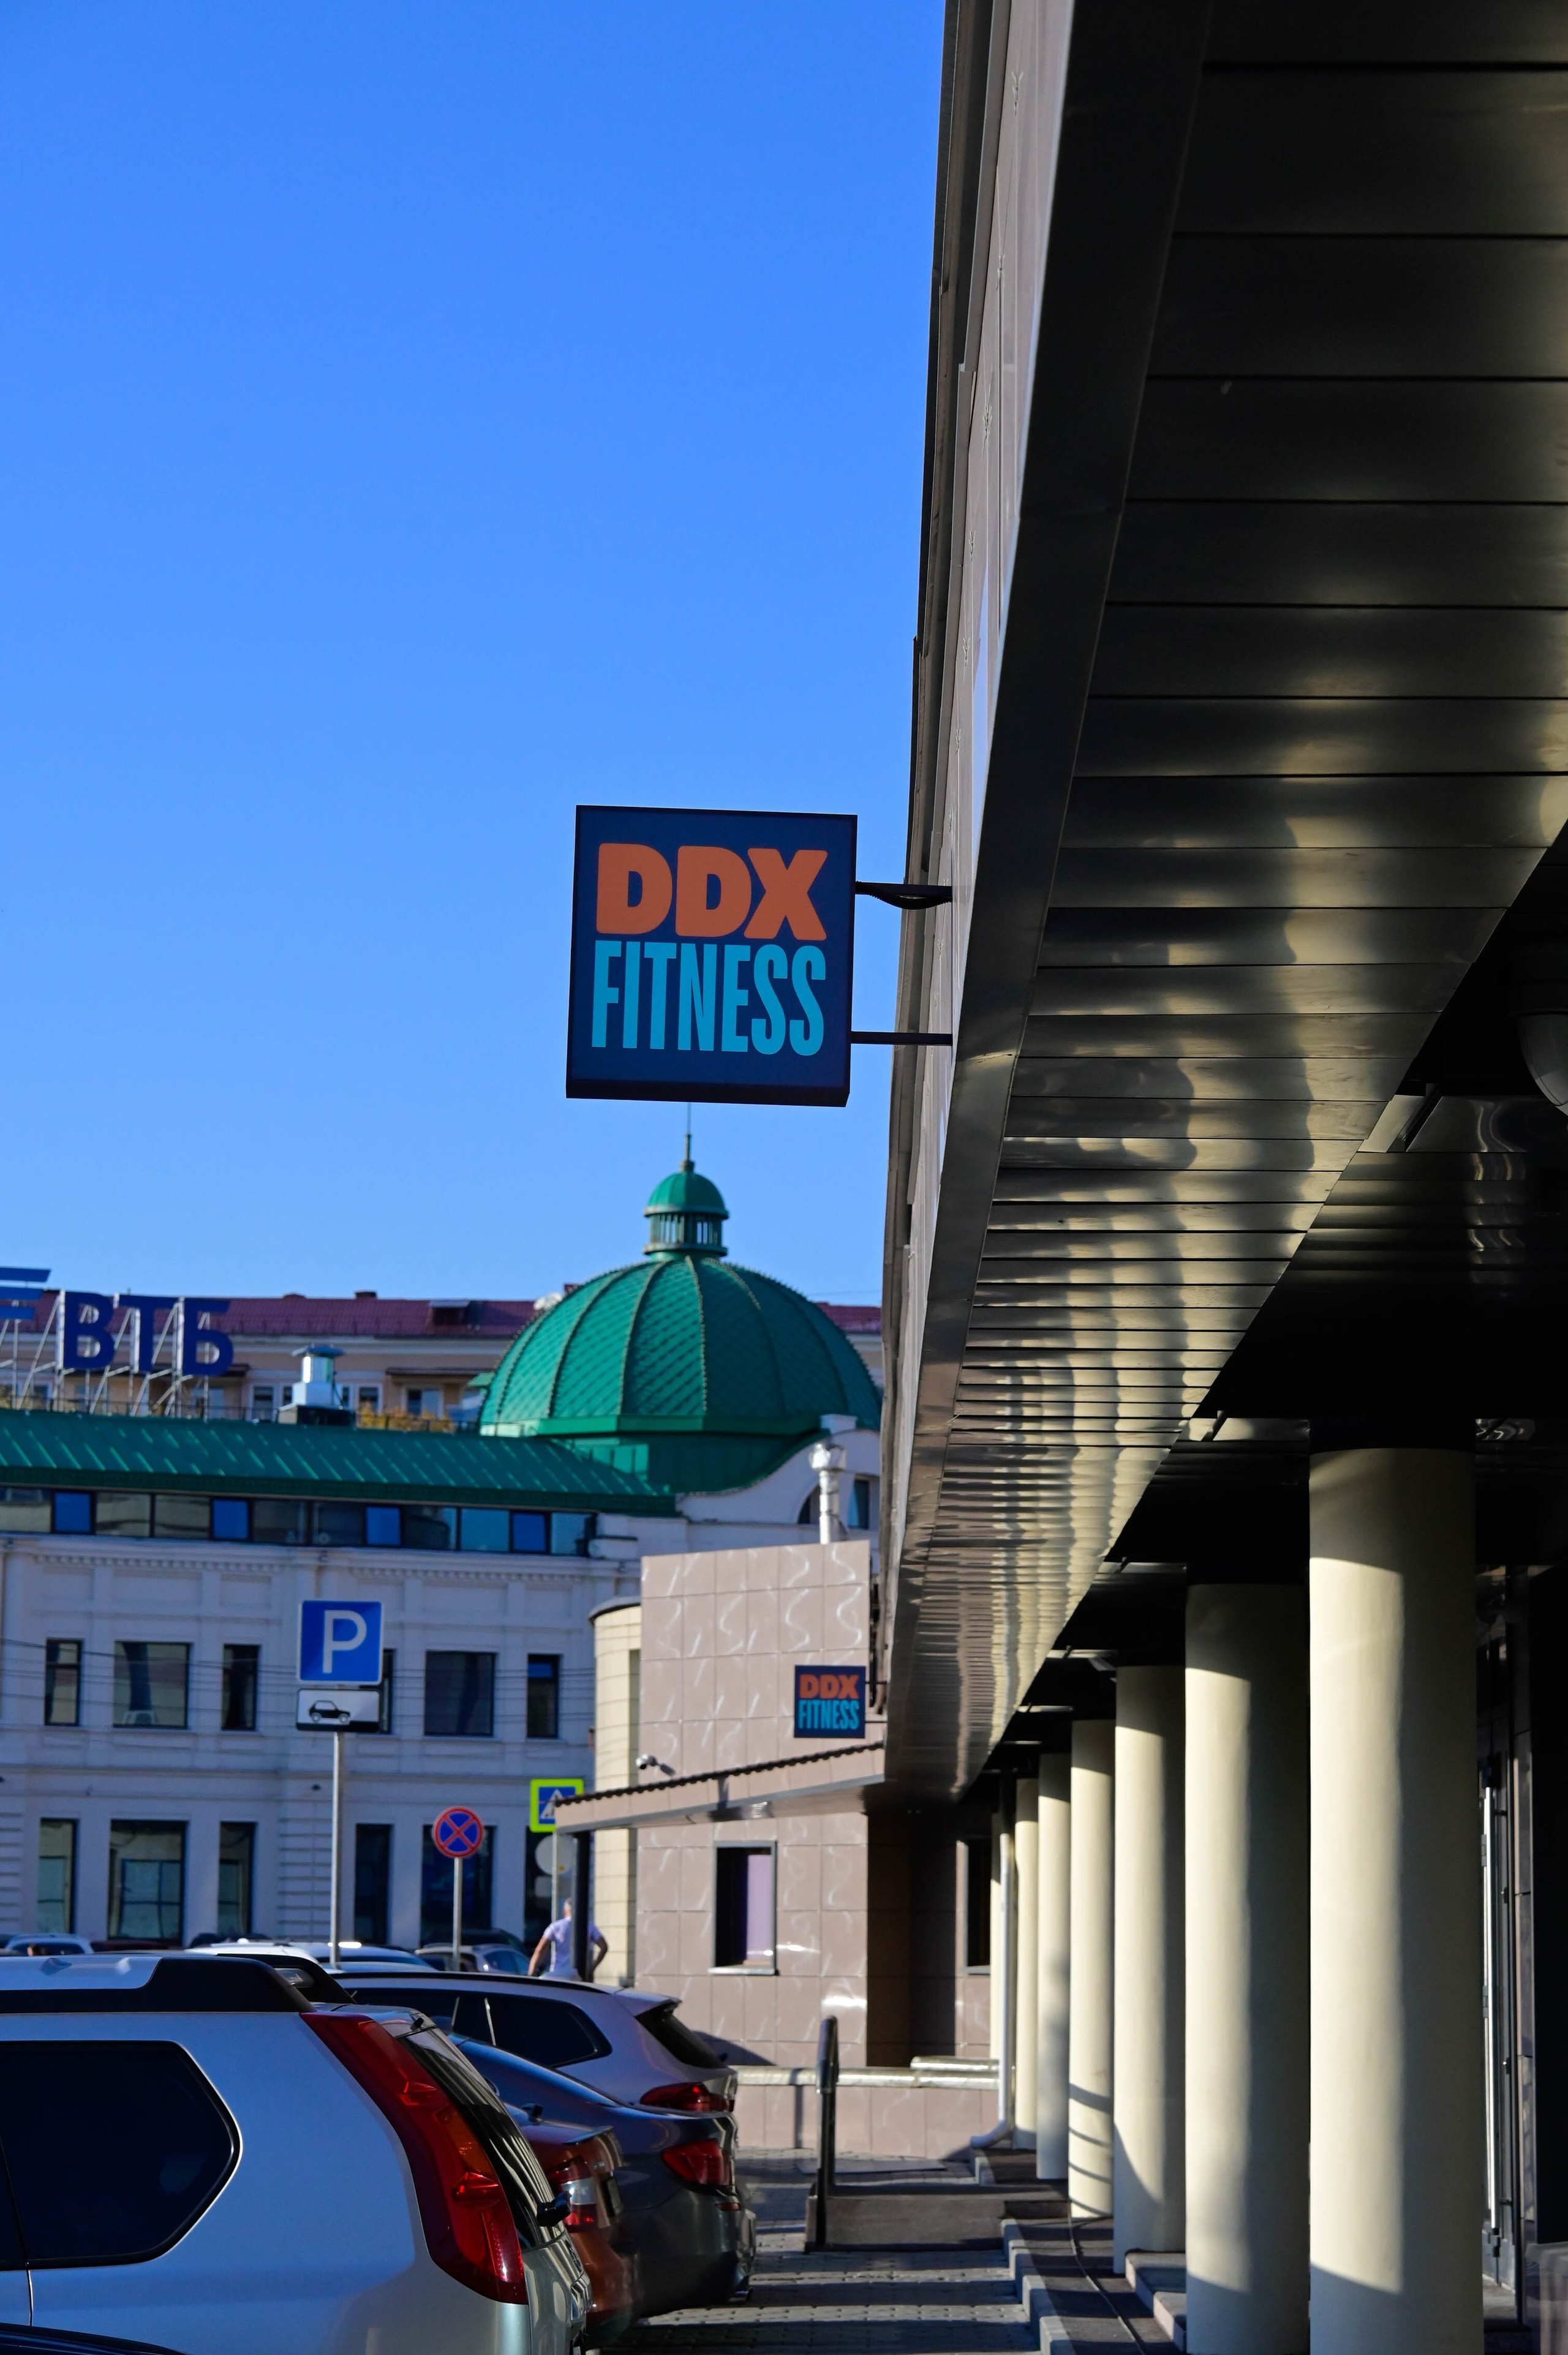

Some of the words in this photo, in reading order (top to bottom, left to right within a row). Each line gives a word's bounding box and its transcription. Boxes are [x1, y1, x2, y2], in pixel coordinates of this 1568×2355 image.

[597, 842, 828, 940] DDX
[592, 940, 826, 1056] FITNESS
[63, 1290, 235, 1376] ВТБ
[322, 1610, 368, 1674] P
[799, 1674, 859, 1699] DDX
[799, 1699, 859, 1729] FITNESS
